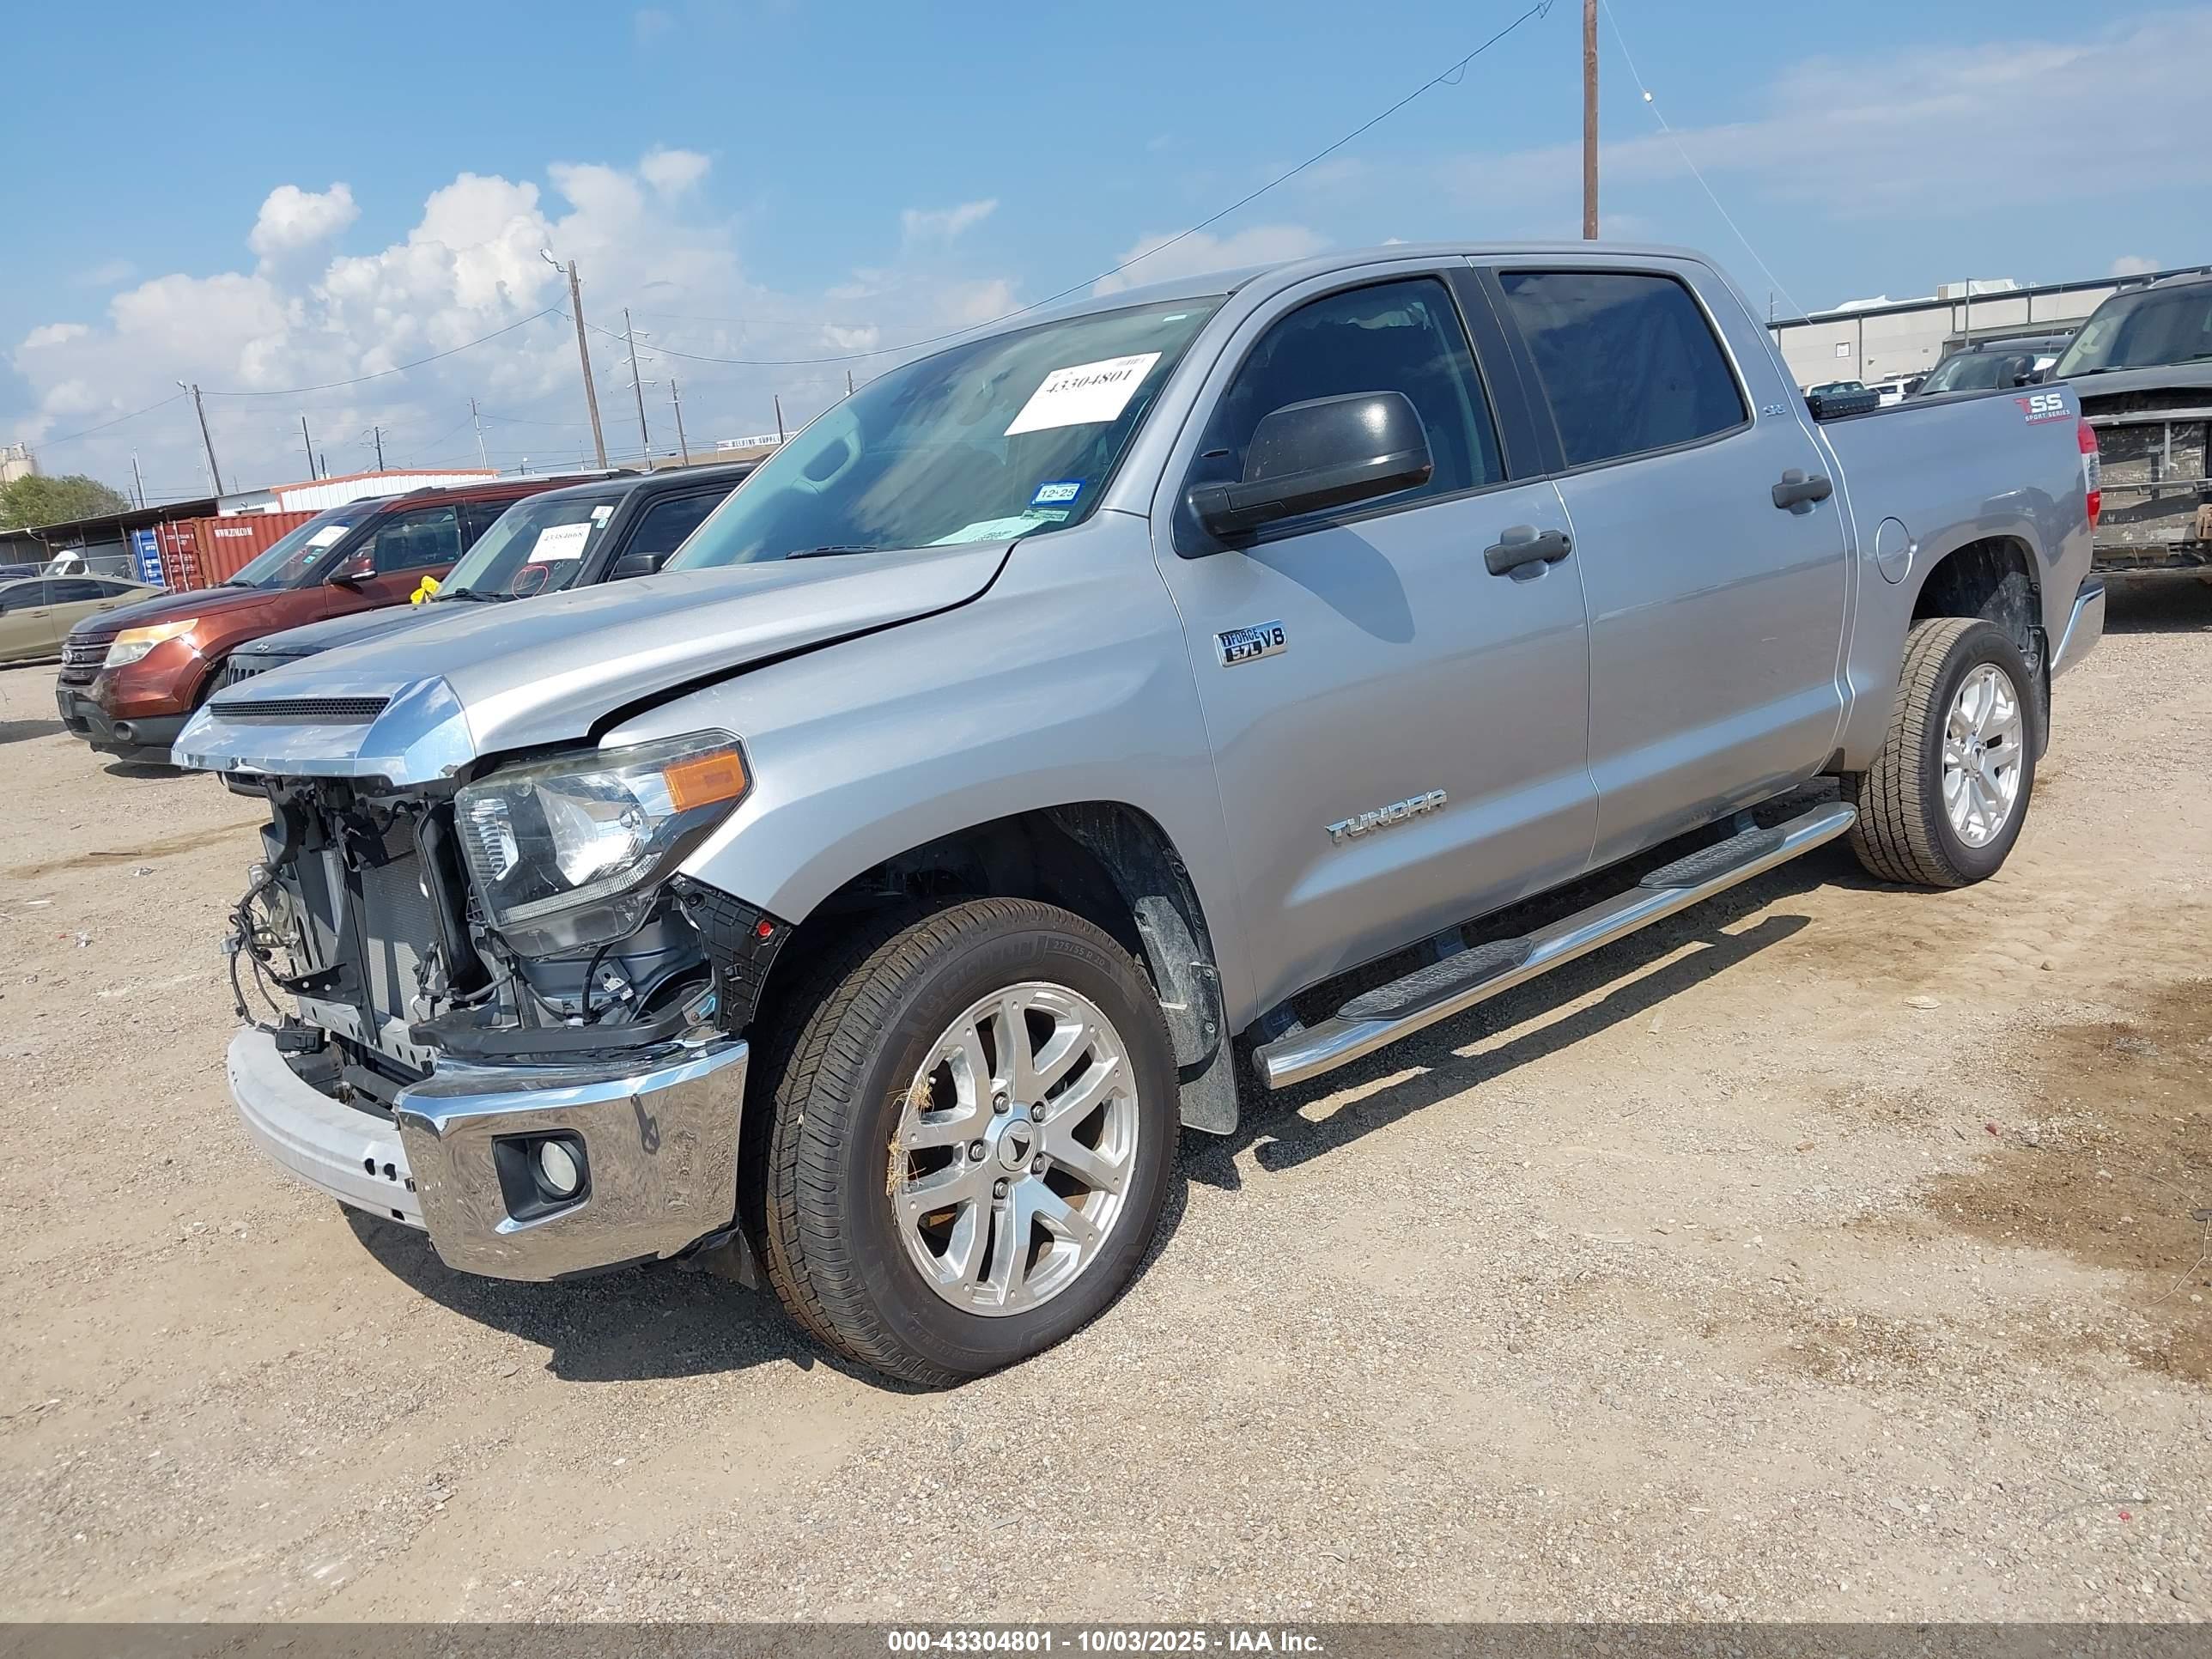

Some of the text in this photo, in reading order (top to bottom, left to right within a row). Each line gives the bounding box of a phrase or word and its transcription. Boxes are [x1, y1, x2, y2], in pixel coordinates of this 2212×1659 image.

[1045, 368, 1133, 394] 43304801
[2024, 409, 2071, 422] SPORT SERIES
[214, 526, 253, 538] WWW.ZIM.COM
[1260, 627, 1285, 647] V8
[1324, 788, 1449, 844] TUNDRA
